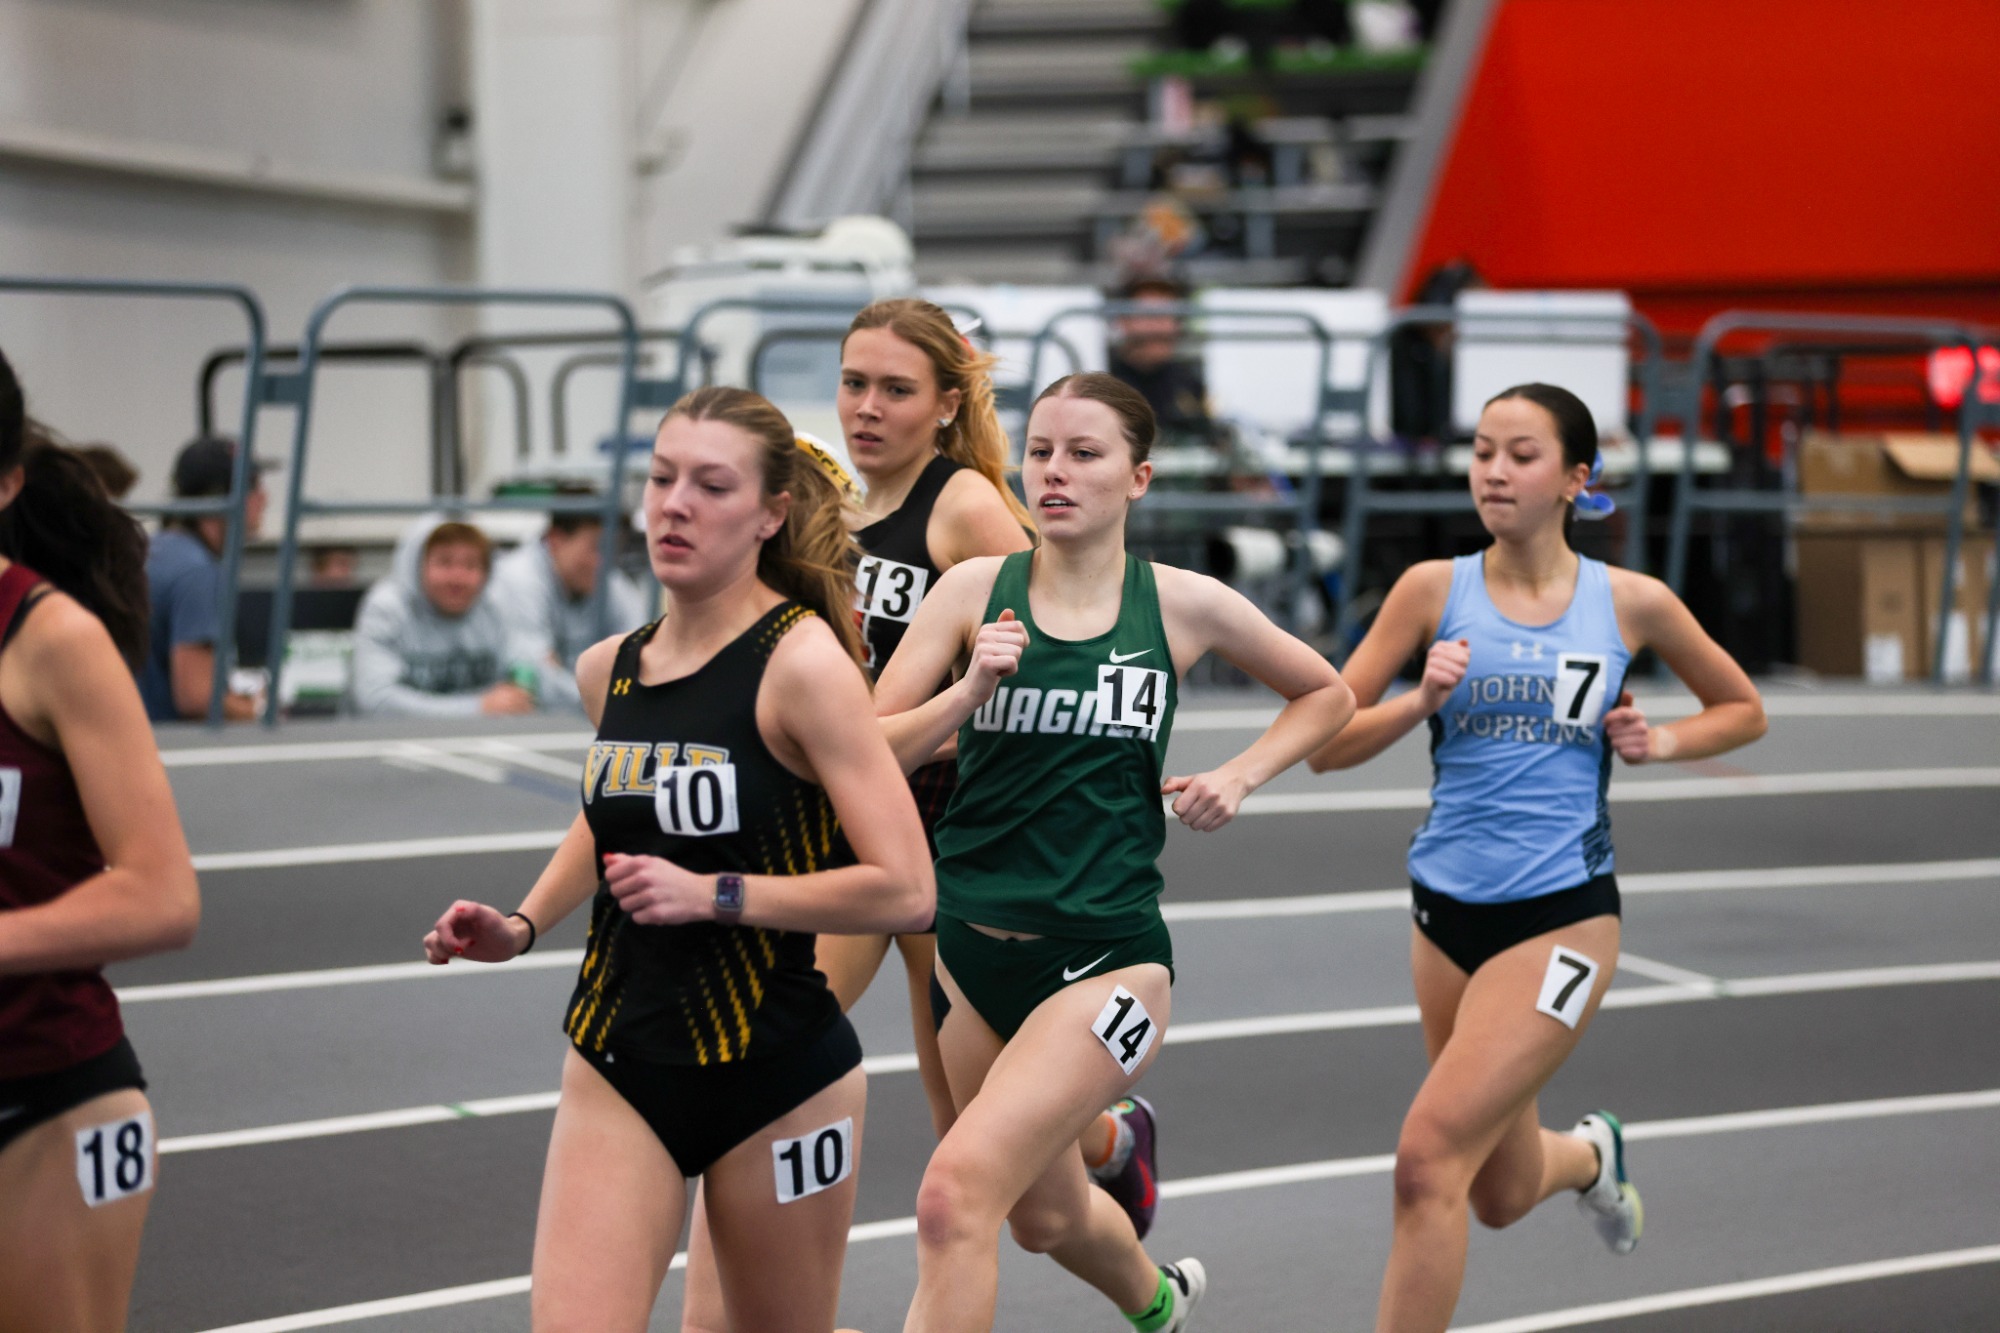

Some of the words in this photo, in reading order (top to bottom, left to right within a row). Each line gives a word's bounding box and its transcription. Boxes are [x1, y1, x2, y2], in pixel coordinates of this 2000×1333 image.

[863, 560, 915, 618] 13
[973, 686, 1158, 743] WAGN
[1103, 667, 1157, 726] 14
[1565, 660, 1601, 720] 7
[661, 769, 724, 833] 10
[1551, 953, 1591, 1013] 7
[1101, 994, 1152, 1065] 14
[82, 1120, 145, 1200] 18
[778, 1127, 844, 1197] 10
